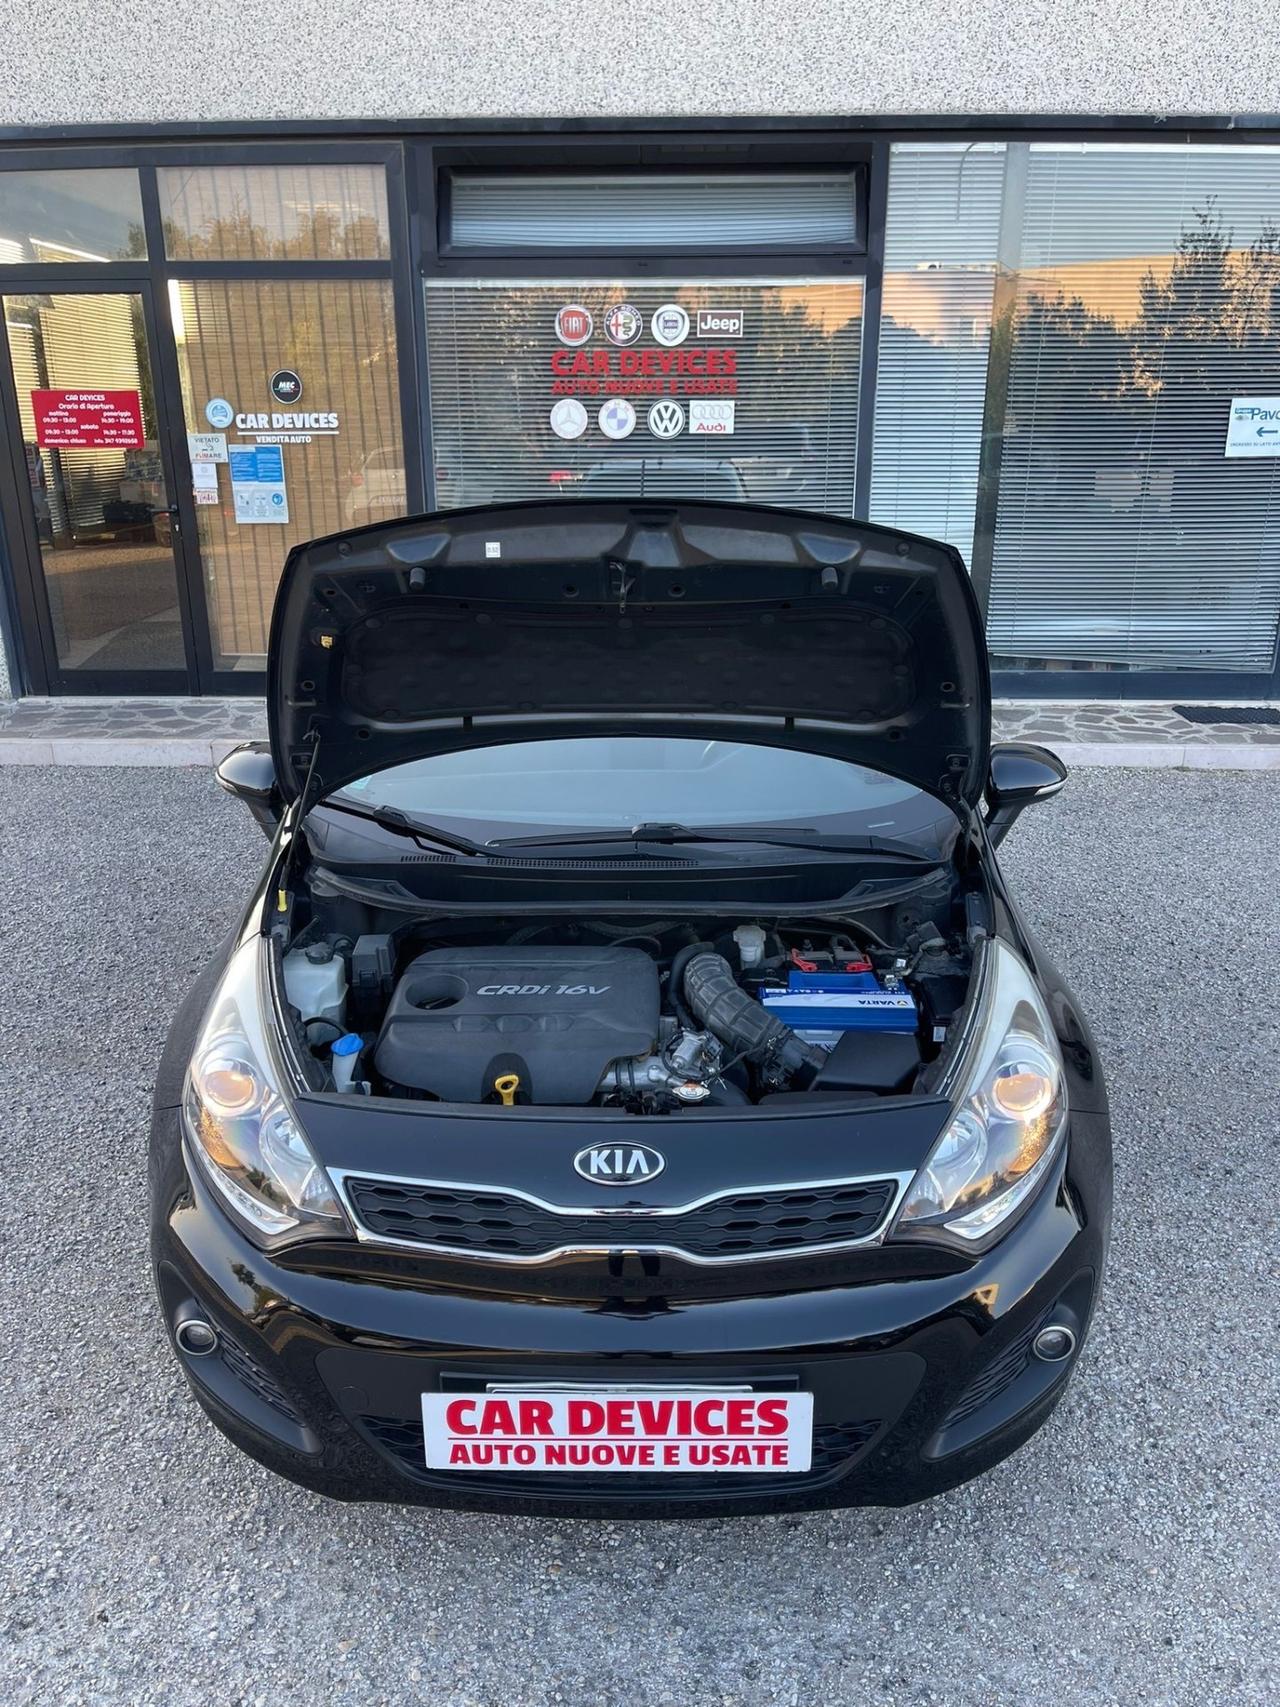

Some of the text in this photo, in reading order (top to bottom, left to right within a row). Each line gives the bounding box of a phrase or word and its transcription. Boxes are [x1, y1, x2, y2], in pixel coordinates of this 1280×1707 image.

[563, 316, 585, 334] FIAT
[700, 315, 739, 332] Jeep
[551, 350, 737, 376] CAR DEVICES
[278, 381, 296, 389] MEC
[552, 379, 737, 395] AUTO NUOVE E USATE
[86, 403, 115, 411] Apertura
[235, 413, 270, 429] CAR
[271, 412, 339, 429] DEVICES
[696, 421, 727, 432] Audi
[256, 435, 312, 444] VENDITA AUTO
[476, 984, 612, 995] CRDi 16V
[590, 1149, 650, 1174] KIA
[446, 1400, 789, 1436] CAR DEVICES
[449, 1444, 789, 1466] AUTO NUOVE E USATE
